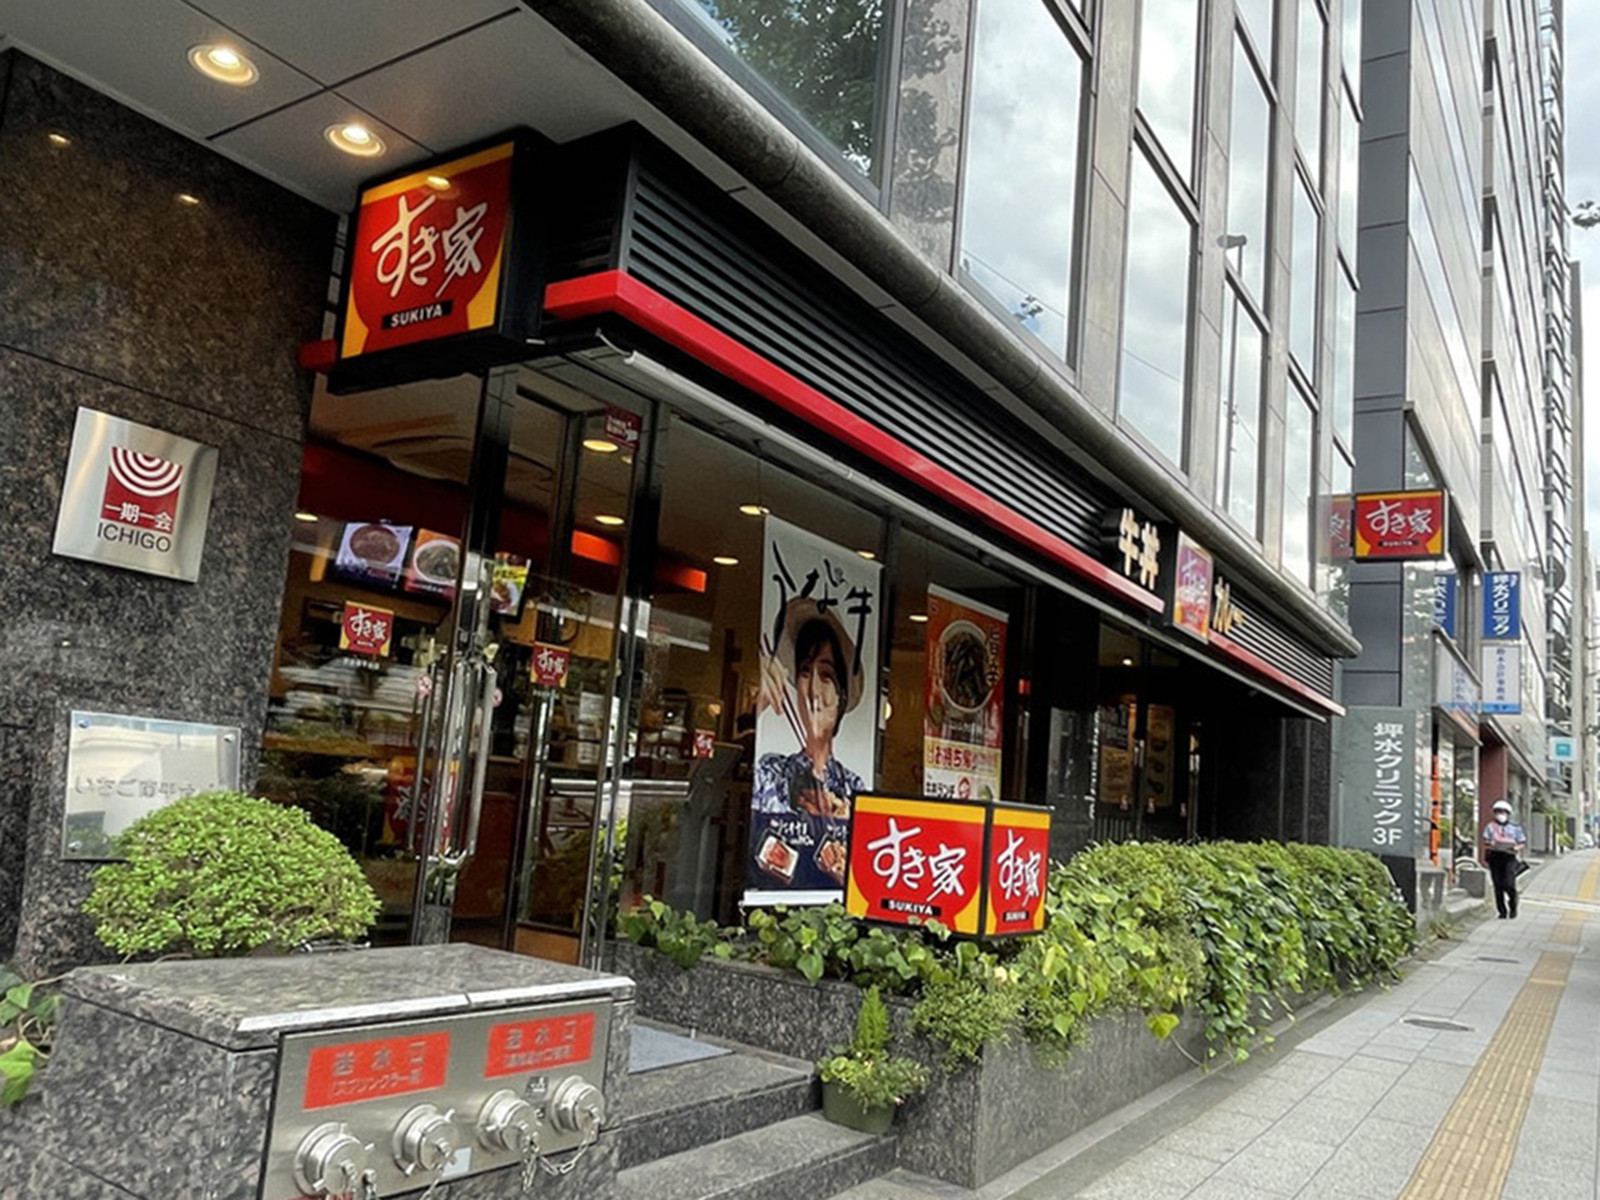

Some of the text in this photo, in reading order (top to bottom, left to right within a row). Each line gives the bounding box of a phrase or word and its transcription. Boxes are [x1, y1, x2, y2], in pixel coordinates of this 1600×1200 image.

[371, 194, 488, 298] すき家
[390, 304, 443, 327] SUKIYA
[104, 502, 173, 532] 一期一会
[1365, 500, 1433, 539] すき家
[97, 522, 171, 553] ICHIGO
[1118, 507, 1160, 590] 牛丼
[349, 608, 388, 642] すき家
[867, 817, 966, 902] すき家
[997, 828, 1041, 907] すき家
[888, 900, 934, 916] SUKIYA
